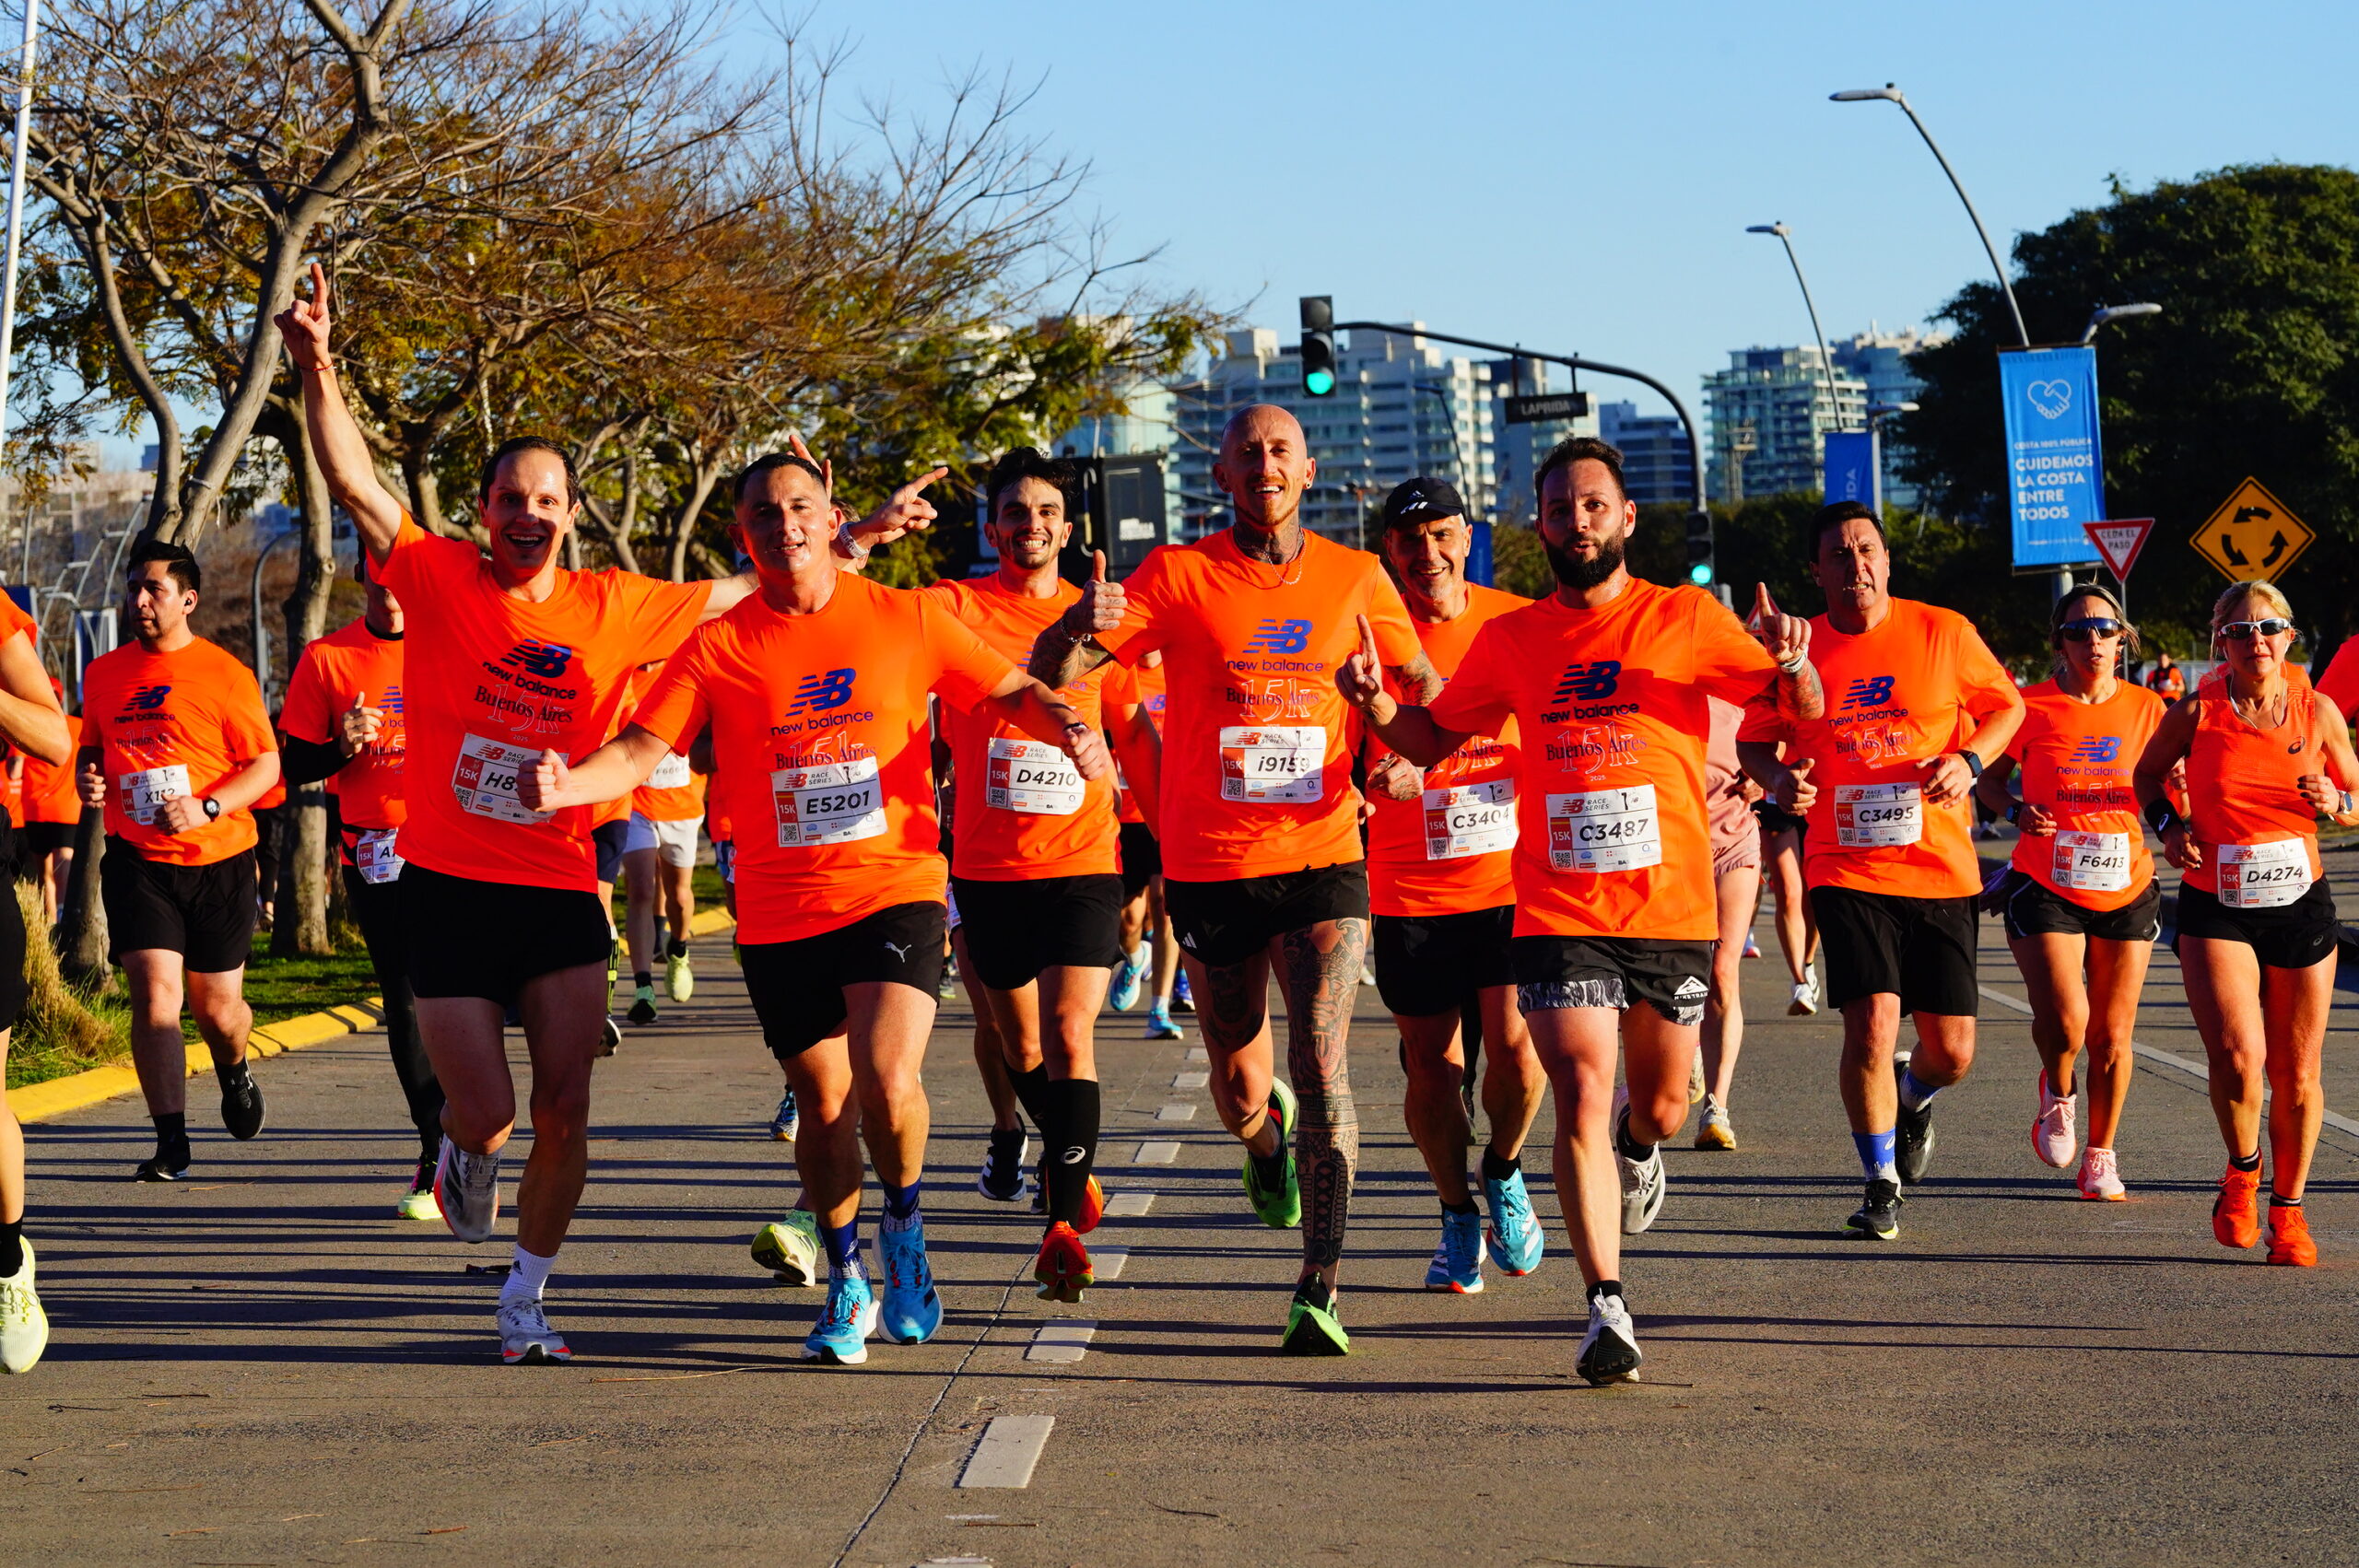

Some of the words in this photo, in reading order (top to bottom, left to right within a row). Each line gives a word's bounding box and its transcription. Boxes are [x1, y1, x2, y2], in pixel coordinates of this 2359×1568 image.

[1520, 400, 1570, 415] LAPRIDA
[2015, 454, 2094, 472] CUIDEMOS
[2016, 474, 2035, 487] LA
[2036, 471, 2085, 486] COSTA
[2018, 489, 2064, 505] ENTRE
[2018, 506, 2070, 521] TODOS
[2101, 530, 2123, 539] CEDA
[2126, 529, 2136, 537] EL
[2108, 541, 2130, 549] PASO
[1226, 660, 1258, 671] new
[1262, 660, 1323, 672] balance
[482, 661, 513, 682] new
[514, 673, 577, 700] balance
[474, 685, 534, 718] Buenos
[536, 704, 573, 723] Aires
[1226, 687, 1282, 706] Buenos
[1287, 691, 1320, 707] Aires
[135, 711, 175, 721] balance
[1541, 709, 1570, 724] new
[1574, 703, 1639, 719] balance
[1828, 716, 1853, 728] new
[1857, 708, 1908, 722] balance
[770, 722, 803, 736] new
[807, 711, 874, 731] balance
[1545, 743, 1602, 761] Buenos
[1609, 737, 1648, 754] Aires
[1836, 741, 1879, 754] Buenos
[507, 751, 526, 760] RACE
[775, 751, 833, 769] Buenos
[839, 746, 877, 764] Aires
[1225, 760, 1243, 770] 15K
[2056, 766, 2081, 775] new
[2084, 766, 2130, 776] balance
[460, 767, 479, 781] 15K
[809, 777, 832, 785] SERIES
[992, 770, 1009, 780] 15K
[1017, 769, 1076, 787] D4210
[806, 790, 870, 814] E5201
[2056, 790, 2101, 803] Buenos
[2105, 792, 2130, 804] Aires
[780, 804, 795, 813] 15K
[1860, 807, 1914, 823] C3495
[1428, 821, 1446, 830] 15K
[1579, 819, 1649, 841] C3487
[1553, 831, 1570, 840] 15K
[359, 852, 372, 860] 15K
[2057, 856, 2071, 864] 15K
[2080, 855, 2125, 868] F6413
[2247, 866, 2304, 883] D4274
